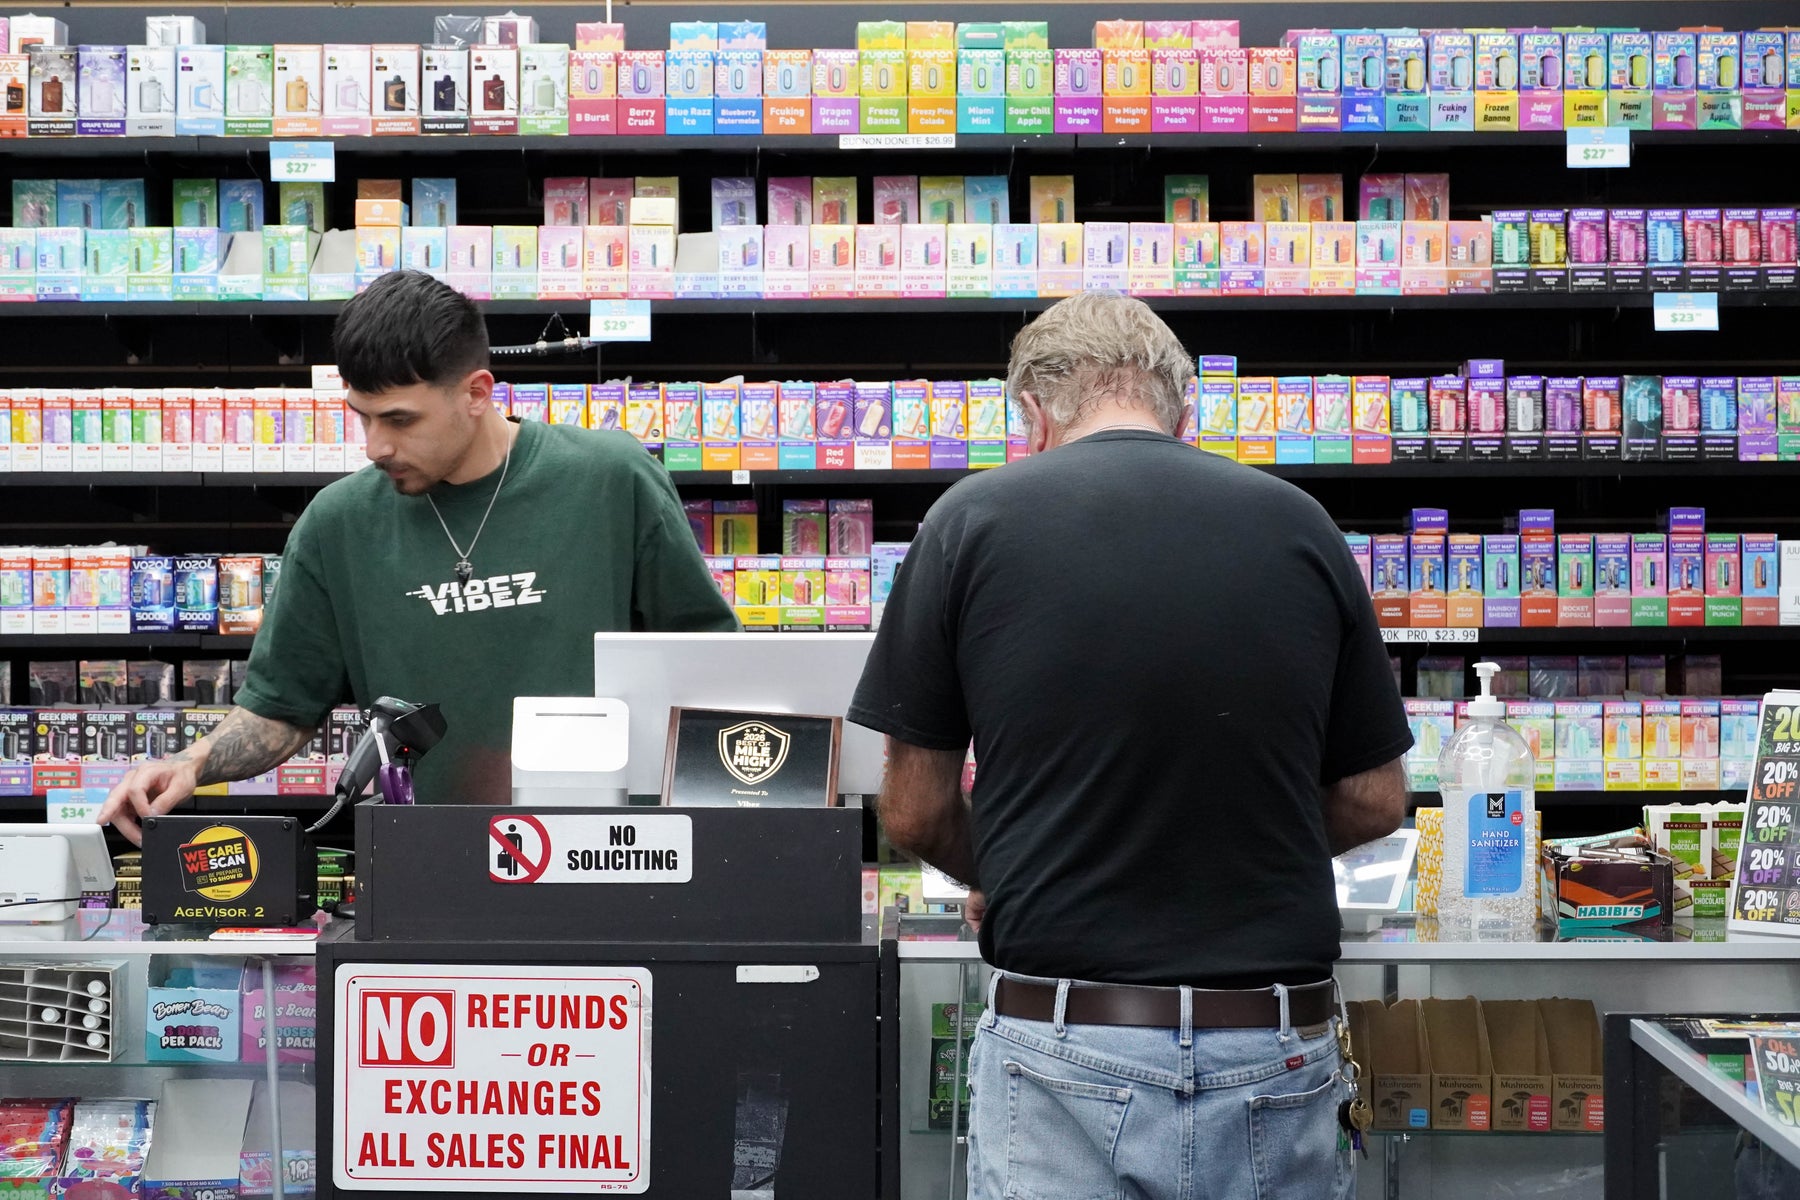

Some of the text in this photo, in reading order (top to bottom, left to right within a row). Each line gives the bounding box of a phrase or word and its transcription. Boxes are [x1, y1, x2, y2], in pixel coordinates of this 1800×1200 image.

[1387, 38, 1424, 47] NEXA
[1525, 36, 1559, 45] NEXA
[1702, 36, 1736, 45] NEXA
[968, 106, 994, 115] Miami
[1008, 106, 1051, 115] Sour Chill
[1252, 107, 1294, 115] Watermelon
[1397, 104, 1419, 112] Citrus
[1438, 104, 1467, 114] Fcuking
[1484, 104, 1510, 112] Frozen
[1574, 103, 1599, 111] Lemon
[1620, 102, 1642, 111] Miami
[629, 108, 656, 118] Berry
[668, 108, 712, 116] Blue Razz
[721, 109, 757, 118] Blueberry
[770, 107, 805, 117] Fcuking
[819, 107, 852, 117] Dragon
[868, 107, 899, 117] Freezy
[1059, 107, 1099, 117] The Mighty
[1108, 107, 1148, 117] The Mighty
[1156, 107, 1196, 117] The Mighty
[1204, 107, 1245, 117] The Mighty
[1622, 113, 1639, 121] Mint
[576, 114, 611, 122] B Burst
[628, 117, 655, 126] Crush
[683, 118, 697, 126] Ice
[779, 117, 796, 125] Fab
[822, 118, 850, 126] Melon
[867, 117, 900, 125] Banana
[971, 117, 991, 125] Mint
[1017, 117, 1042, 126] Apple
[1067, 117, 1089, 126] Grape
[1115, 117, 1140, 126] Mango
[1164, 117, 1187, 125] Peach
[1212, 116, 1235, 124] Straw
[1268, 115, 1278, 123] Ice
[1483, 114, 1511, 123] Banana
[925, 135, 954, 146] $26.99
[1583, 148, 1606, 160] $27
[1671, 312, 1694, 323] $23
[826, 448, 844, 456] Red
[738, 559, 778, 569] GEEK BAR
[827, 560, 868, 569] GEEK BAR
[414, 572, 544, 615] VIBEZ
[1407, 630, 1428, 640] PRO
[1435, 630, 1476, 641] $23.99
[1409, 702, 1452, 712] GEEK BAR
[38, 712, 78, 722] GEEK BAR
[87, 713, 126, 722] GEEK BAR
[735, 745, 771, 757] MILE
[1775, 742, 1790, 753] BIG
[733, 755, 771, 767] HIGH
[1763, 761, 1798, 784] 20%
[1766, 782, 1796, 799] OFF
[61, 807, 85, 818] $34
[1756, 805, 1791, 828] 20%
[609, 825, 636, 847] NO
[1482, 830, 1510, 838] HAND
[1759, 826, 1788, 842] OFF
[1471, 839, 1519, 847] SANITIZER
[184, 843, 243, 863] WE CARE
[186, 854, 246, 874] WE SCAN
[567, 850, 678, 871] SOLICITING
[1750, 848, 1785, 870] 20%
[218, 874, 235, 882] SHOW
[1753, 869, 1782, 884] OFF
[1694, 897, 1725, 905] CHOCOLATE
[1744, 889, 1779, 910] 20%
[255, 906, 265, 917] 2
[1577, 906, 1642, 917] HABIBI'S
[1747, 908, 1776, 921] OFF
[190, 999, 230, 1020] Bears
[177, 1026, 219, 1037] DOSES
[366, 994, 628, 1063] NO REFUNDS
[161, 1036, 222, 1048] PER PACK
[527, 1043, 570, 1067] OR
[1378, 1080, 1422, 1089] Mushrooms
[1439, 1080, 1483, 1089] Mushrooms
[1501, 1080, 1544, 1089] Mushrooms
[384, 1079, 601, 1117] EXCHANGES
[358, 1132, 630, 1170] ALL SALES FINAL
